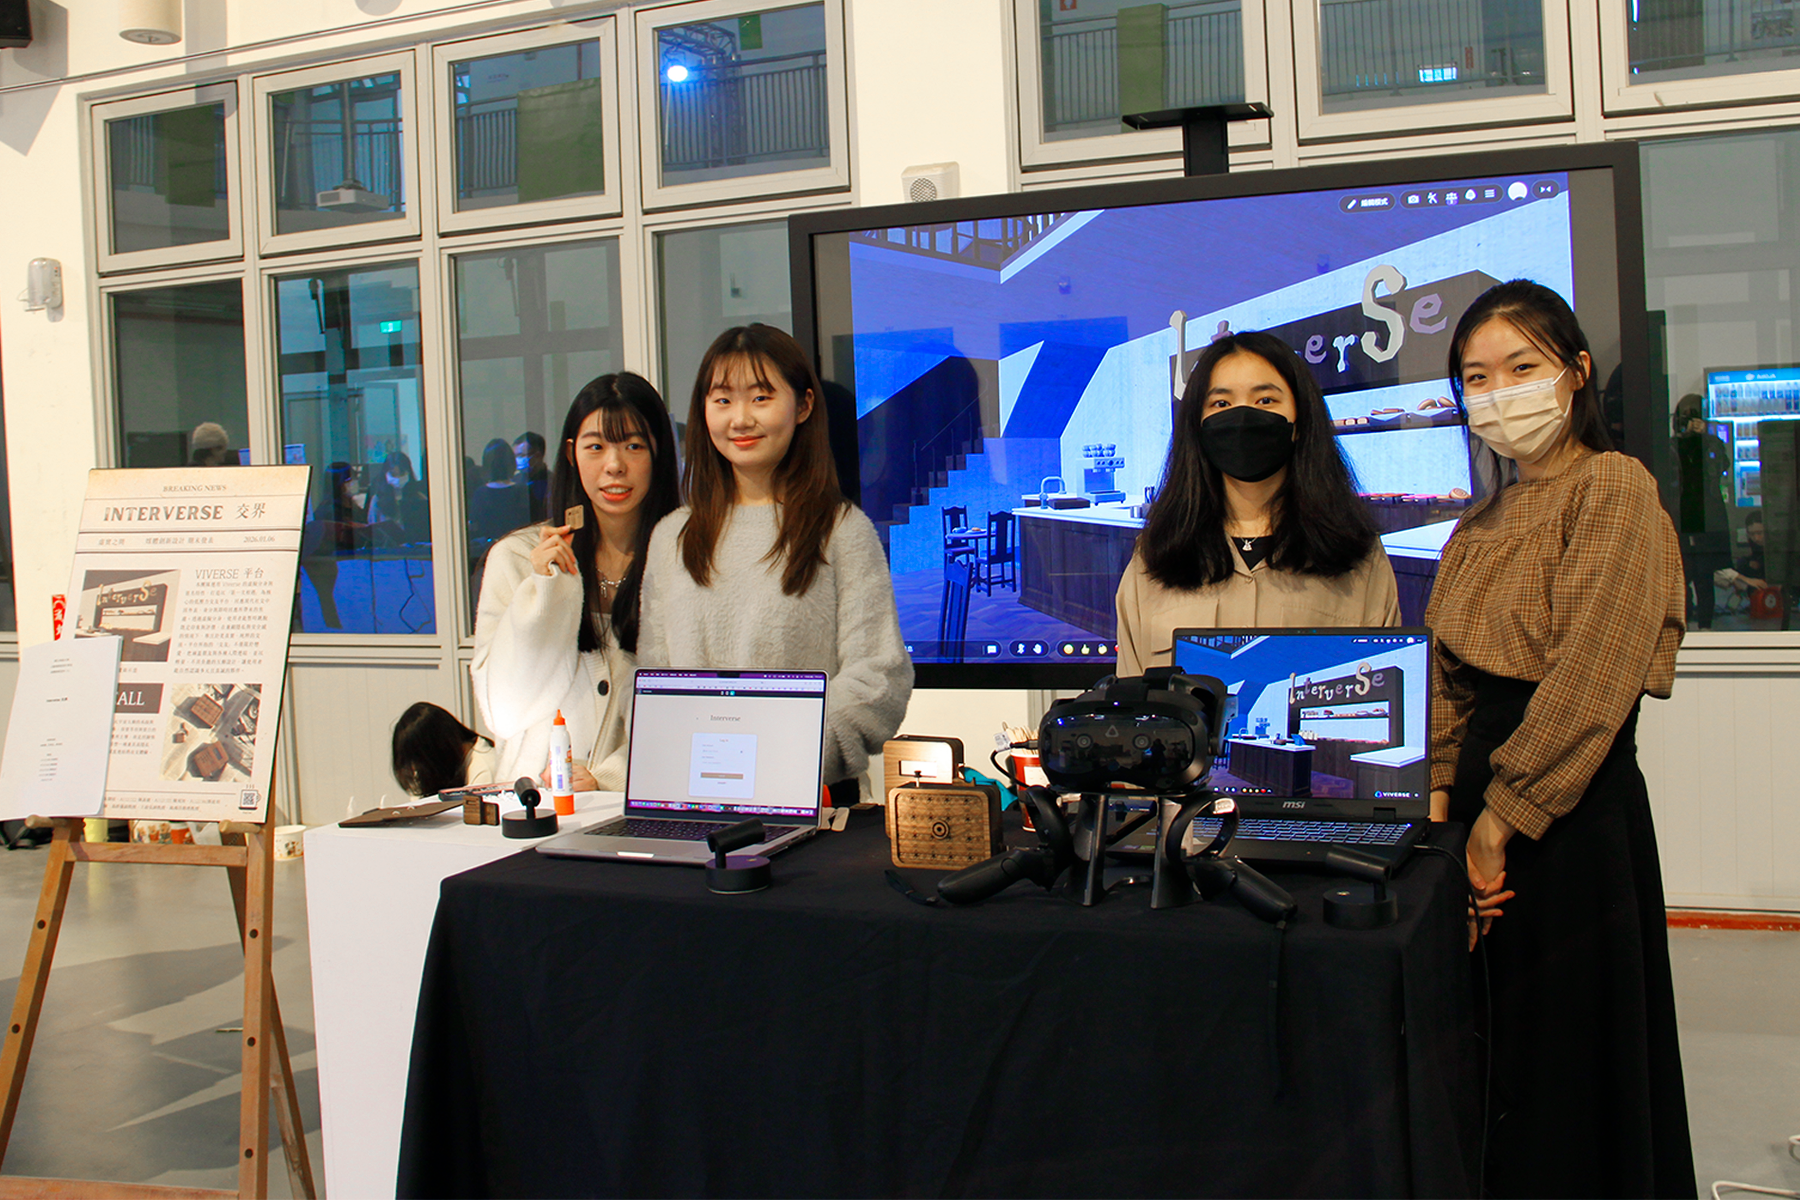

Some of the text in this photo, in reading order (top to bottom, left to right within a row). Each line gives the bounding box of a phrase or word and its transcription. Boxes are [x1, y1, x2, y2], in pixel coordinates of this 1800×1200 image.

[103, 502, 266, 521] INTERVERSE 交界
[195, 567, 264, 579] VIVERSE 平台
[1288, 661, 1386, 704] InterverSe
[116, 691, 145, 706] ALL
[1282, 801, 1306, 809] msi
